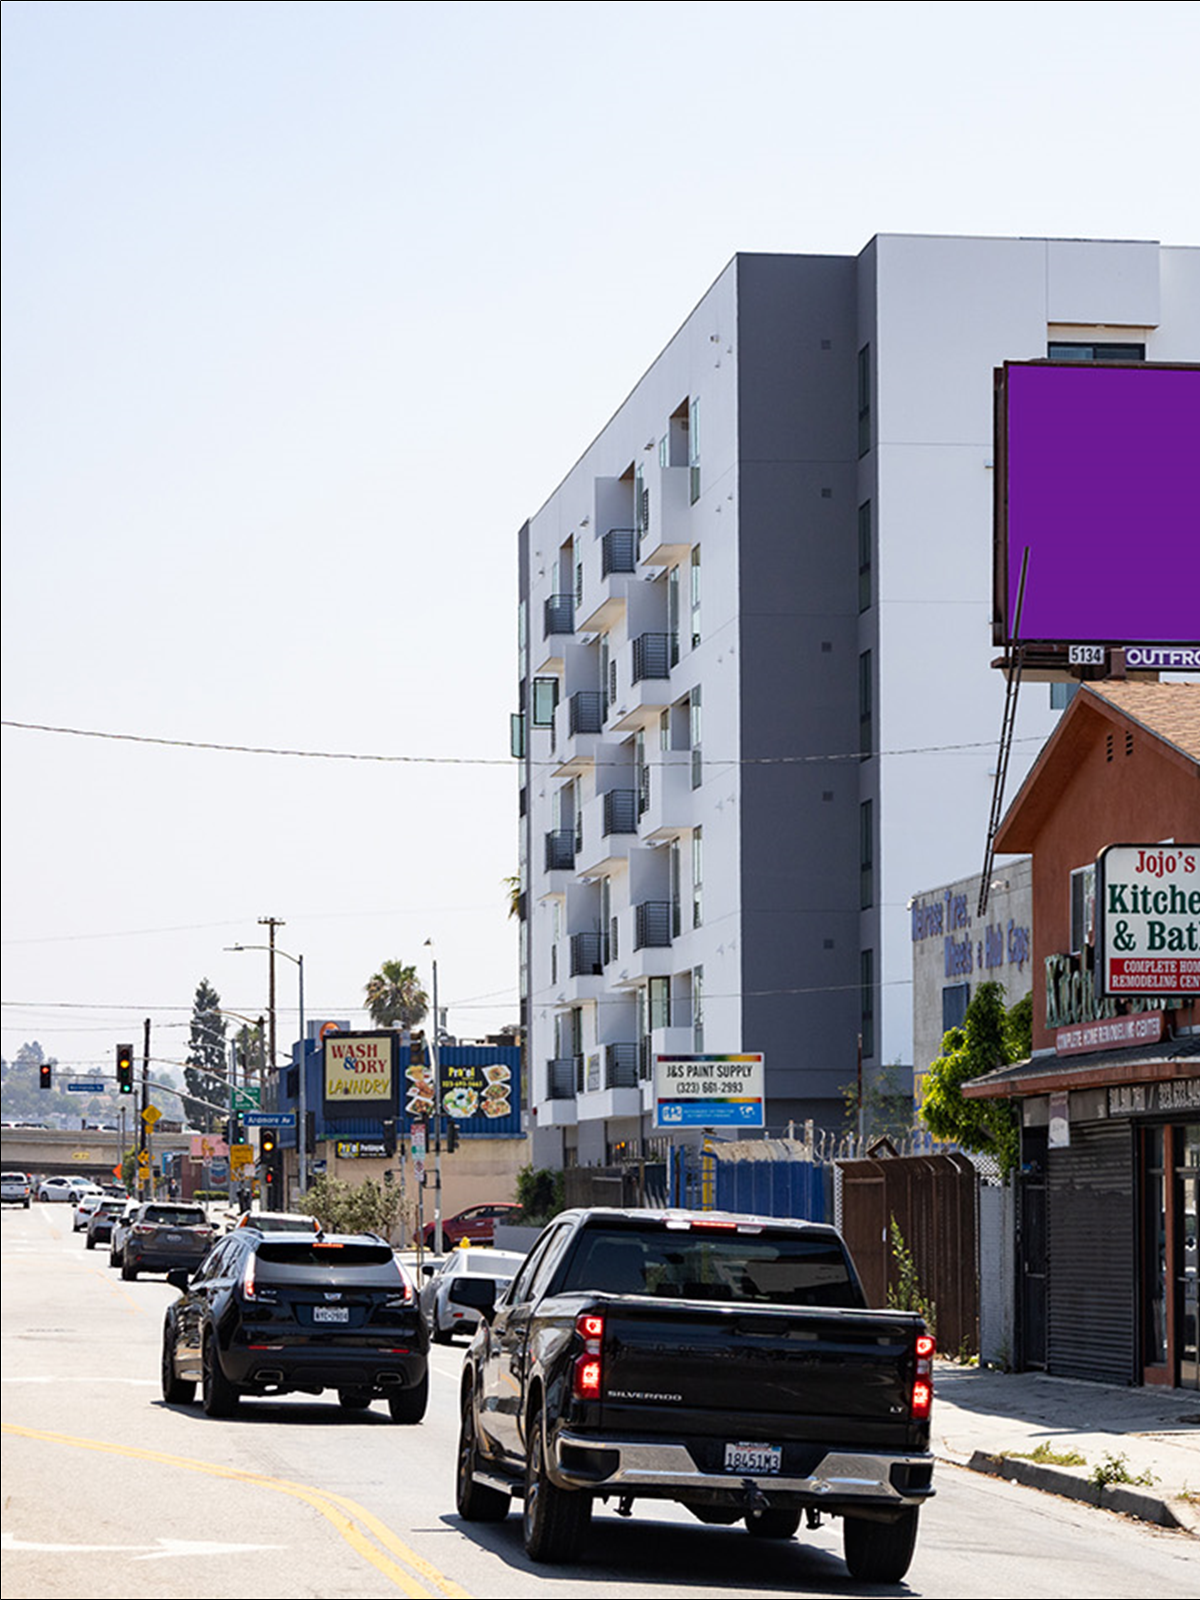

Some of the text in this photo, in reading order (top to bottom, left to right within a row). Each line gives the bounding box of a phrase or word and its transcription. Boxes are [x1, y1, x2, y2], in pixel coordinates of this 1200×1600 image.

[1071, 646, 1102, 663] 5134
[1135, 850, 1197, 878] Jojo's
[1112, 919, 1137, 952] &
[1123, 960, 1178, 974] COMPLETE
[1111, 975, 1177, 989] REMODELING
[331, 1043, 378, 1059] WASH
[342, 1055, 388, 1074] & DRY
[666, 1064, 753, 1078] J&S PAINT SUPPLY
[327, 1077, 391, 1096] LAUNDRY
[676, 1081, 700, 1094] (323)
[607, 1390, 683, 1402] SILVERADO
